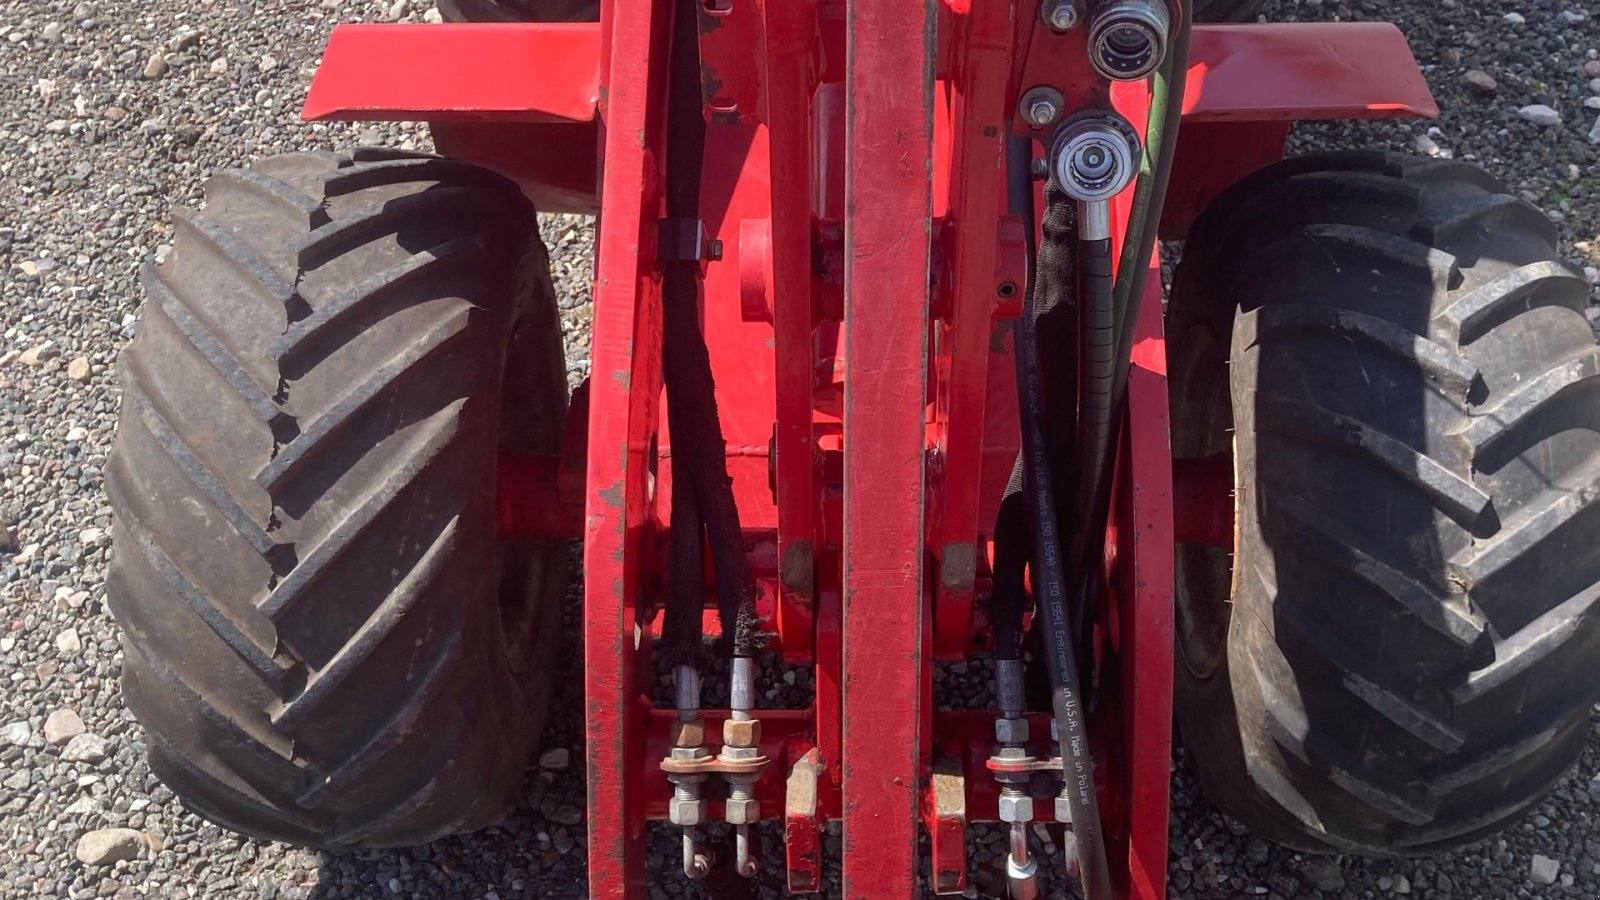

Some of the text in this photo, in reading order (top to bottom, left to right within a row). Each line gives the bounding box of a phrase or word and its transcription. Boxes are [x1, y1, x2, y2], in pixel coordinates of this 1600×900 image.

[1034, 451, 1043, 462] to
[1049, 581, 1060, 597] ISO
[1055, 631, 1071, 682] Engineered
[1063, 687, 1072, 698] in
[1066, 701, 1078, 732] U.S.A.
[1071, 736, 1081, 757] Made
[1075, 762, 1084, 773] in
[1078, 775, 1090, 805] Poland
